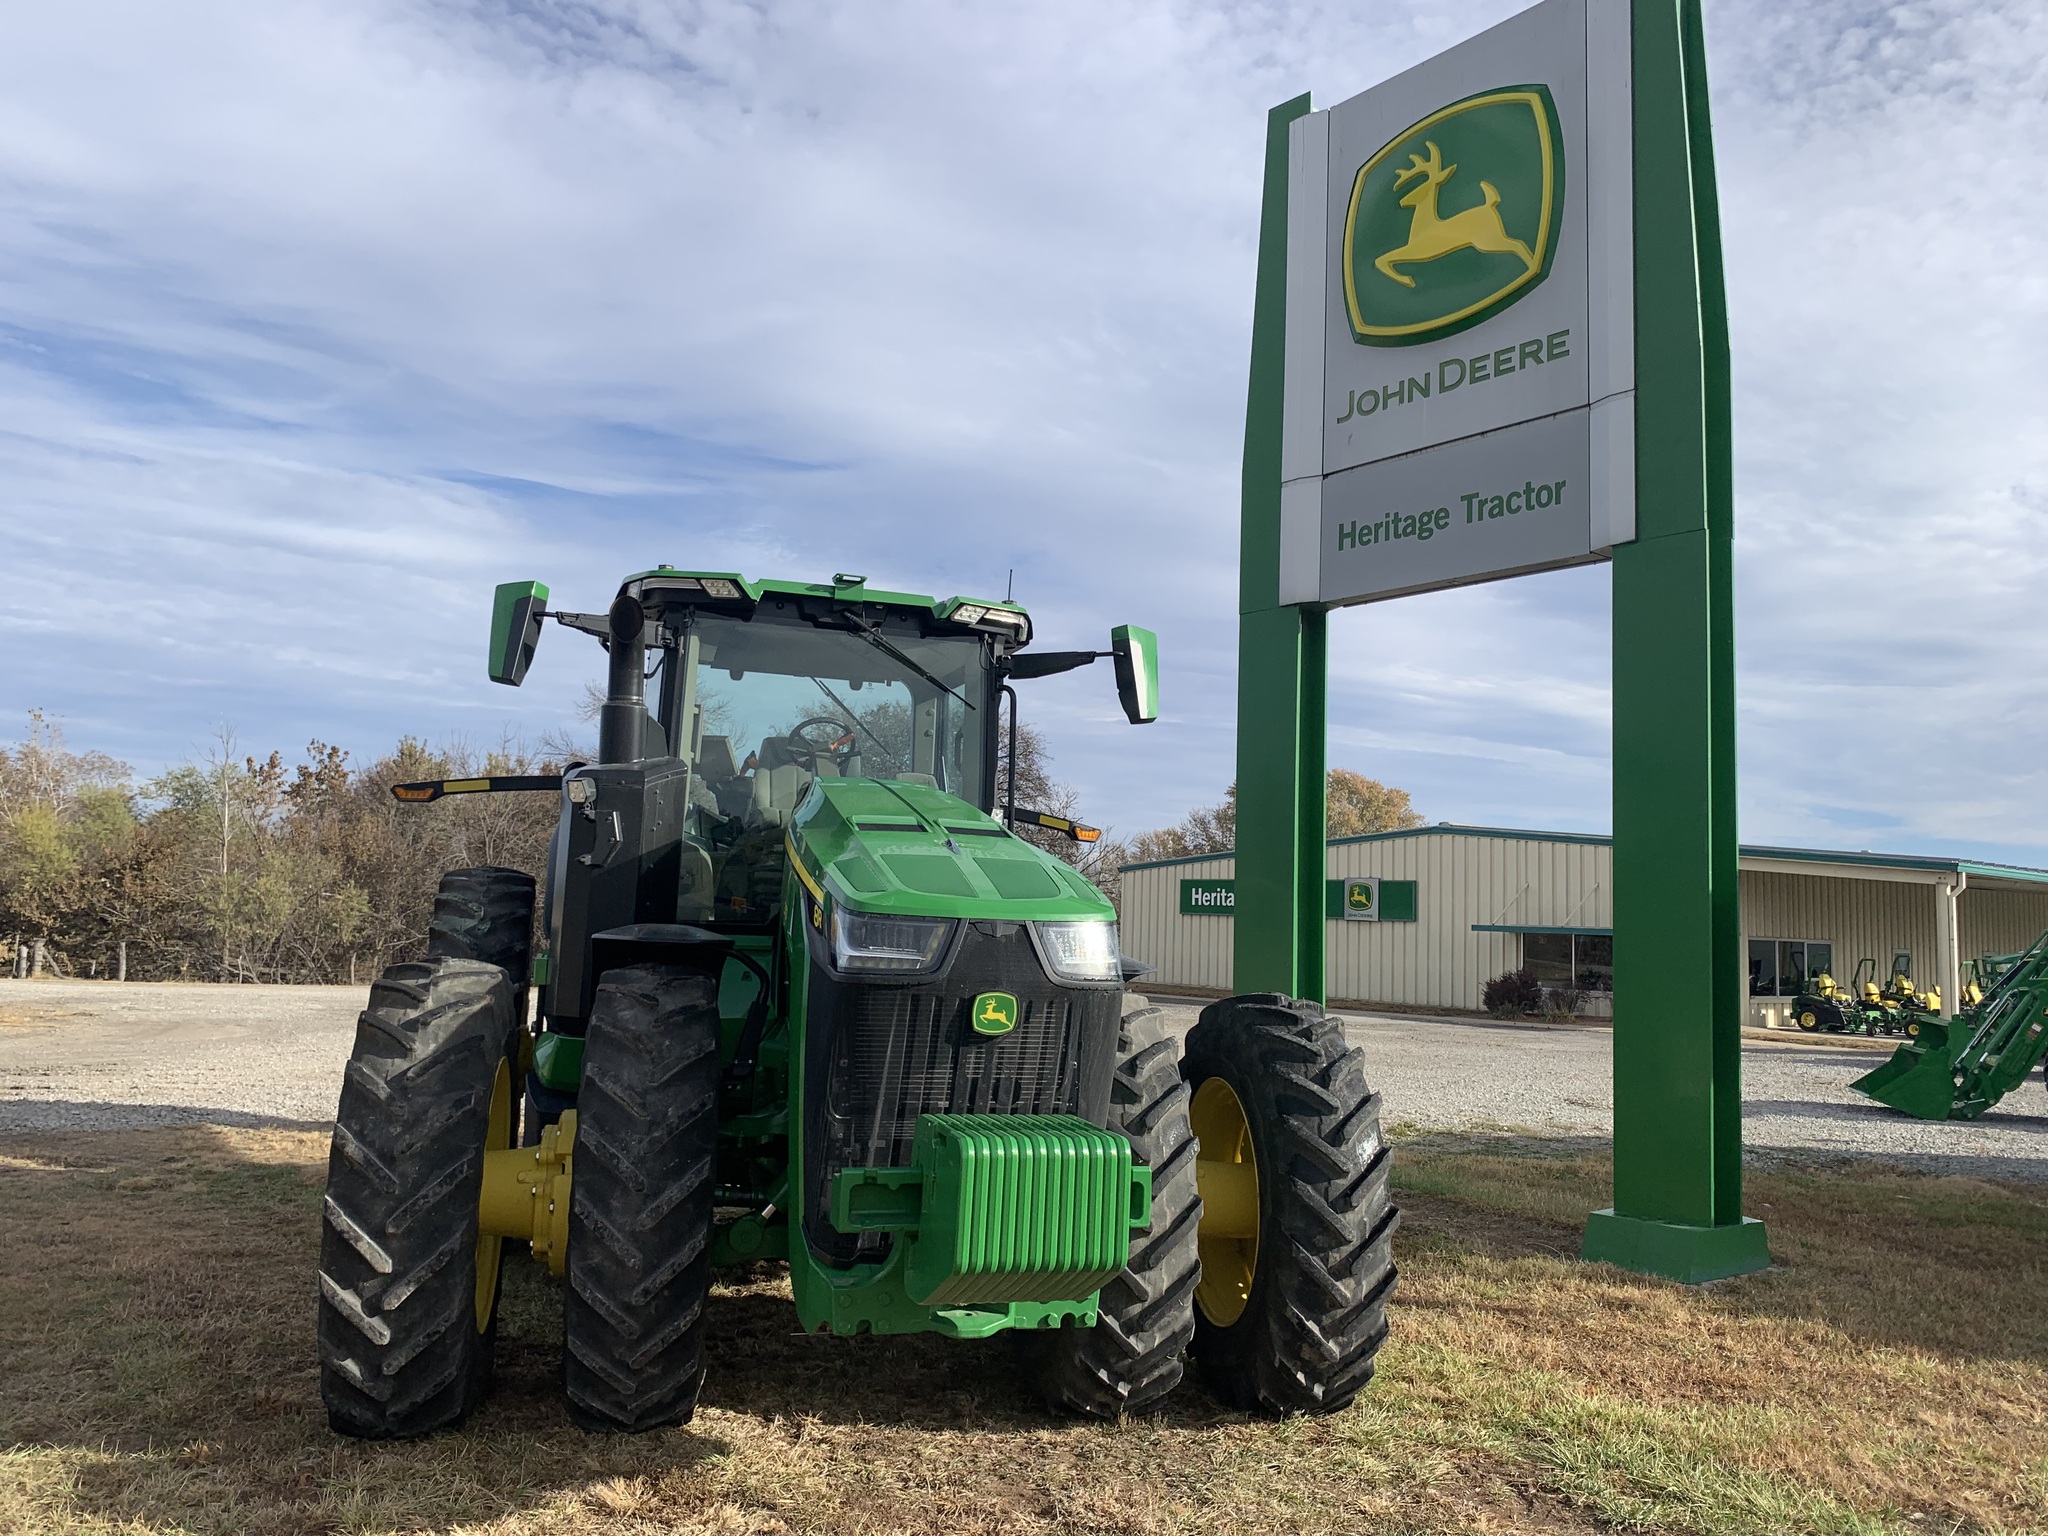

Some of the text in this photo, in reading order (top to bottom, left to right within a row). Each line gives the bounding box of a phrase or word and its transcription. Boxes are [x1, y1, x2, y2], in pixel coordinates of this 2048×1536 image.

[1337, 329, 1570, 424] JOHN DEERE
[1338, 480, 1567, 551] Heritage Tractor
